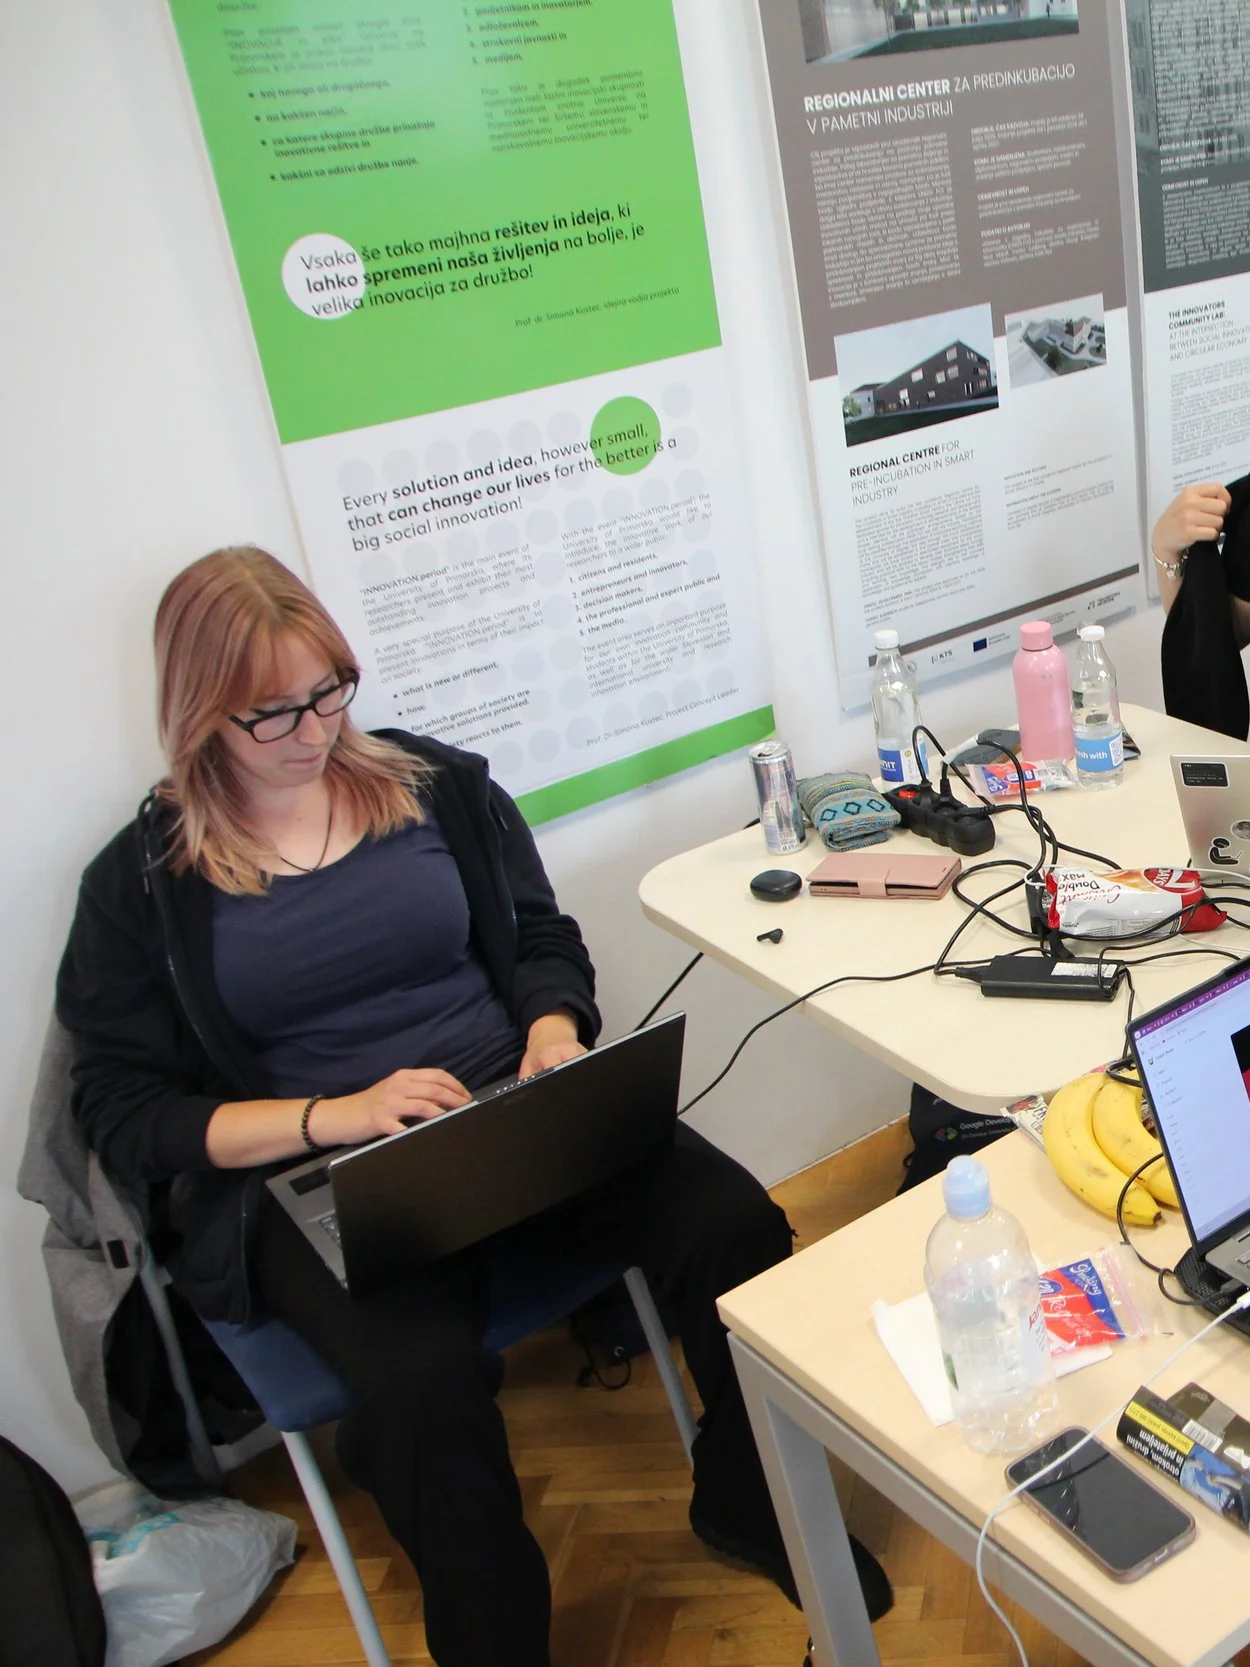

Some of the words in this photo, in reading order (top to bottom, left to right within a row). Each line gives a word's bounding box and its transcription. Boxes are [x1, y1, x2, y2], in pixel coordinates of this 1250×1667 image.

[804, 85, 894, 112] REGIONALNI
[896, 78, 950, 100] CENTER
[953, 75, 970, 92] ZA
[973, 62, 1075, 90] PREDINKUBACIJO
[807, 119, 817, 134] V
[821, 110, 881, 132] PAMETNI
[884, 100, 953, 123] INDUSTRIJI
[300, 248, 358, 271] Vsaka
[359, 244, 381, 261] še
[384, 238, 425, 257] tako
[427, 227, 492, 254] majhna
[493, 219, 549, 239] rešitev
[552, 216, 567, 229] in
[570, 209, 615, 229] ideja,
[616, 203, 632, 217] ki
[305, 270, 358, 294] lahko
[361, 257, 444, 288] spremeni
[445, 249, 488, 269] naša
[491, 238, 560, 265] življenja
[562, 237, 583, 249] na
[586, 227, 628, 248] bolje,
[629, 224, 646, 240] je
[310, 293, 365, 317] velika
[367, 279, 446, 311] inovacija
[449, 278, 469, 292] za
[471, 263, 534, 288] družbo!
[649, 287, 679, 300] projekta
[1168, 310, 1180, 318] THE
[1182, 301, 1224, 316] INNOVATORS
[1168, 314, 1210, 329] COMMUNITY
[1169, 337, 1197, 350] BETWEEN
[1199, 332, 1220, 343] SOCIAL
[1179, 329, 1188, 337] THE
[1191, 319, 1233, 335] INTERSECTION
[1170, 351, 1183, 361] AND
[1185, 344, 1214, 357] CIRCULAR
[1217, 337, 1246, 350] ECONOMY
[342, 487, 389, 515] Every
[390, 469, 459, 499] solution
[461, 461, 495, 481] and
[496, 450, 537, 472] idea,
[539, 434, 603, 462] however
[605, 423, 647, 445] small,
[849, 455, 900, 477] REGIONAL
[902, 445, 939, 463] CENTRE
[941, 440, 959, 452] FOR
[851, 461, 930, 492] PRE-INCUBATION
[933, 458, 942, 469] IN
[944, 449, 974, 466] SMART
[346, 510, 383, 532] that
[387, 505, 418, 521] can
[420, 485, 483, 516] change
[485, 481, 512, 496] our
[513, 467, 551, 488] lives
[553, 461, 575, 478] for
[577, 454, 603, 472] the
[604, 442, 650, 465] better
[652, 438, 664, 453] is
[667, 438, 677, 449] a
[852, 485, 897, 506] INDUSTRY
[351, 532, 381, 555] big
[382, 519, 431, 543] social
[434, 495, 522, 530] innovation!
[366, 606, 416, 628] outstanding
[427, 591, 468, 609] innovation
[520, 572, 535, 582] and
[414, 588, 444, 604] present
[447, 583, 462, 593] and
[514, 563, 533, 574] most
[585, 612, 597, 621] the
[599, 597, 643, 619] professional
[644, 592, 659, 603] and
[660, 585, 682, 599] expert
[684, 578, 704, 592] public
[706, 573, 720, 583] and
[402, 684, 424, 696] what
[434, 677, 449, 686] new
[411, 722, 422, 732] for
[424, 714, 447, 727] which
[449, 707, 476, 721] groups
[478, 702, 486, 710] of
[488, 693, 515, 709] society
[517, 690, 530, 698] are
[614, 722, 639, 736] Simona
[665, 705, 688, 720] Project
[689, 695, 716, 712] Concept
[717, 687, 739, 700] Leader
[1089, 752, 1108, 760] with
[1058, 880, 1100, 892] Double
[960, 1120, 984, 1131] Google
[1126, 1433, 1150, 1457] družini
[1139, 1429, 1176, 1462] prijateljem
[1150, 1450, 1180, 1476] otrokom,
[1177, 1456, 1185, 1468] in
